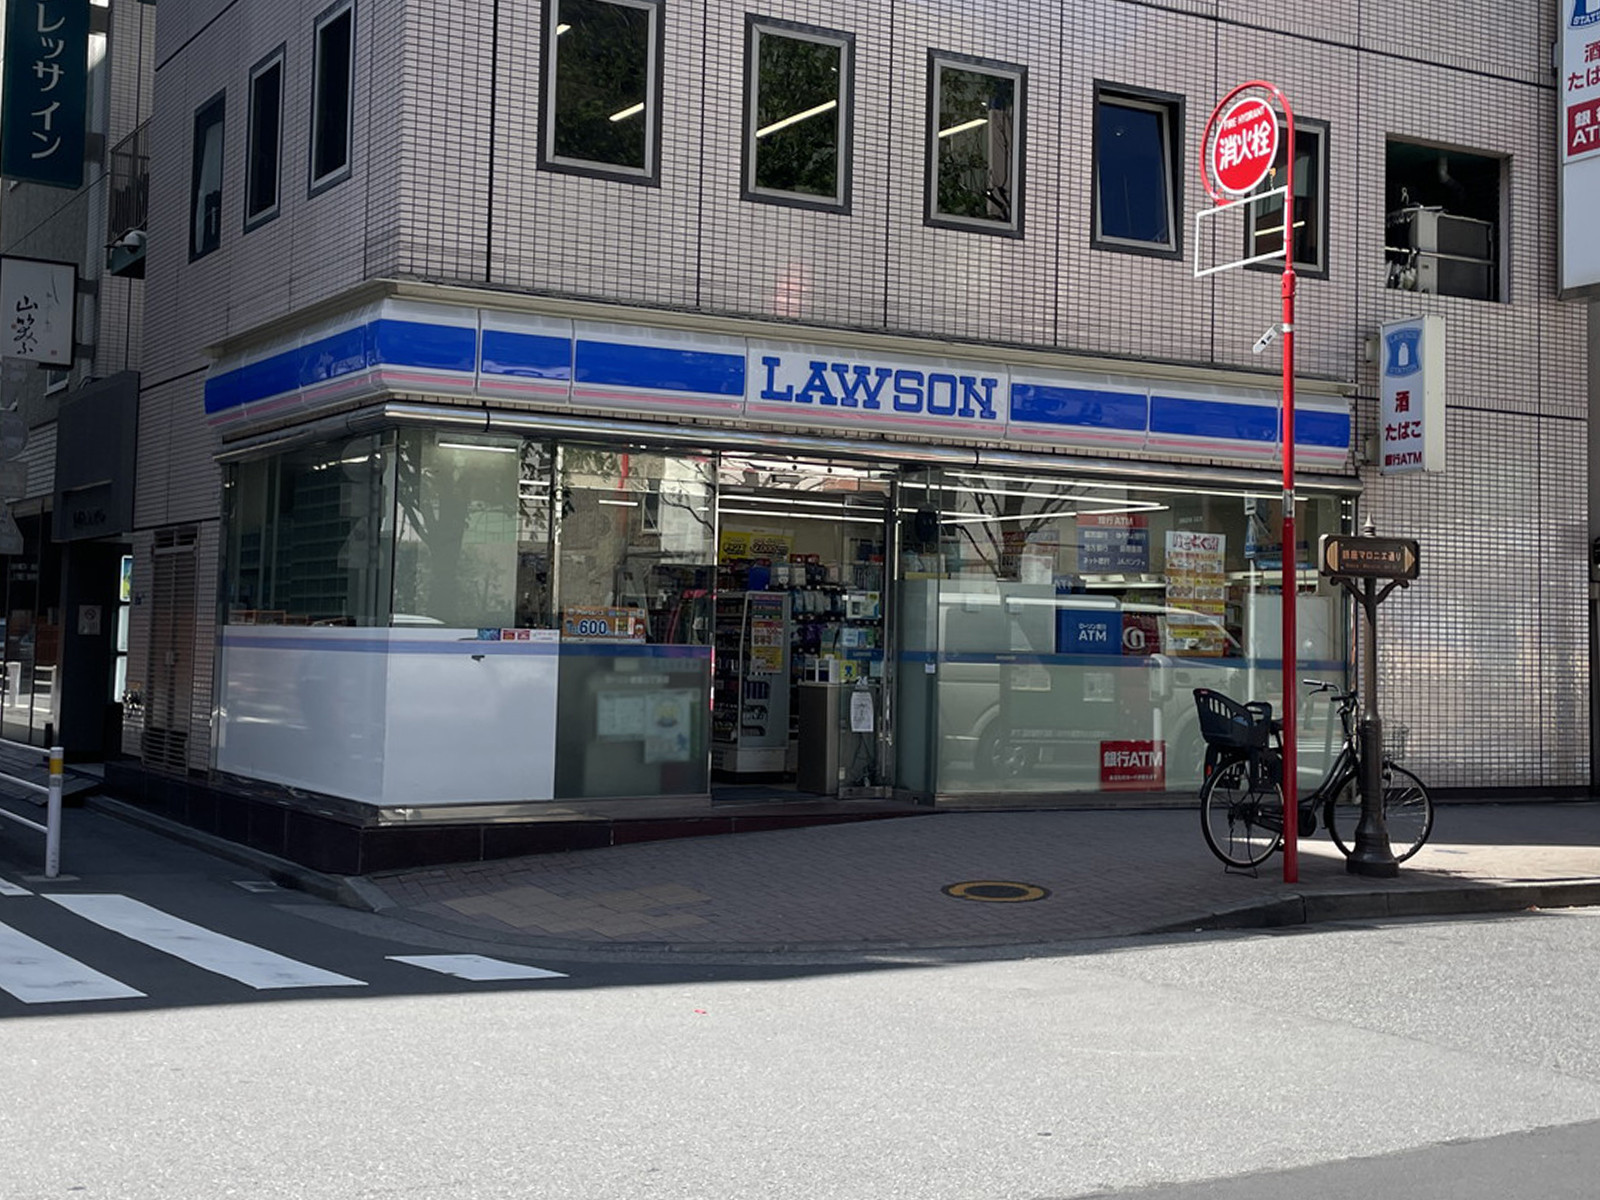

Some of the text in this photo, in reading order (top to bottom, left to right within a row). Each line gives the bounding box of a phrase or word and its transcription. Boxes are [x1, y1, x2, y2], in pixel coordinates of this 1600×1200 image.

[31, 0, 66, 159] レッサイン
[1574, 106, 1600, 128] 銀
[1219, 120, 1272, 171] 消火栓
[1572, 125, 1600, 147] AT
[761, 356, 998, 420] LAWSON
[1395, 391, 1410, 413] 酒
[1385, 421, 1422, 441] たばこ
[1385, 451, 1422, 466] 銀行ATM
[580, 619, 608, 635] 600
[1078, 630, 1107, 641] ATM
[1104, 751, 1163, 767] 銀行ATM
